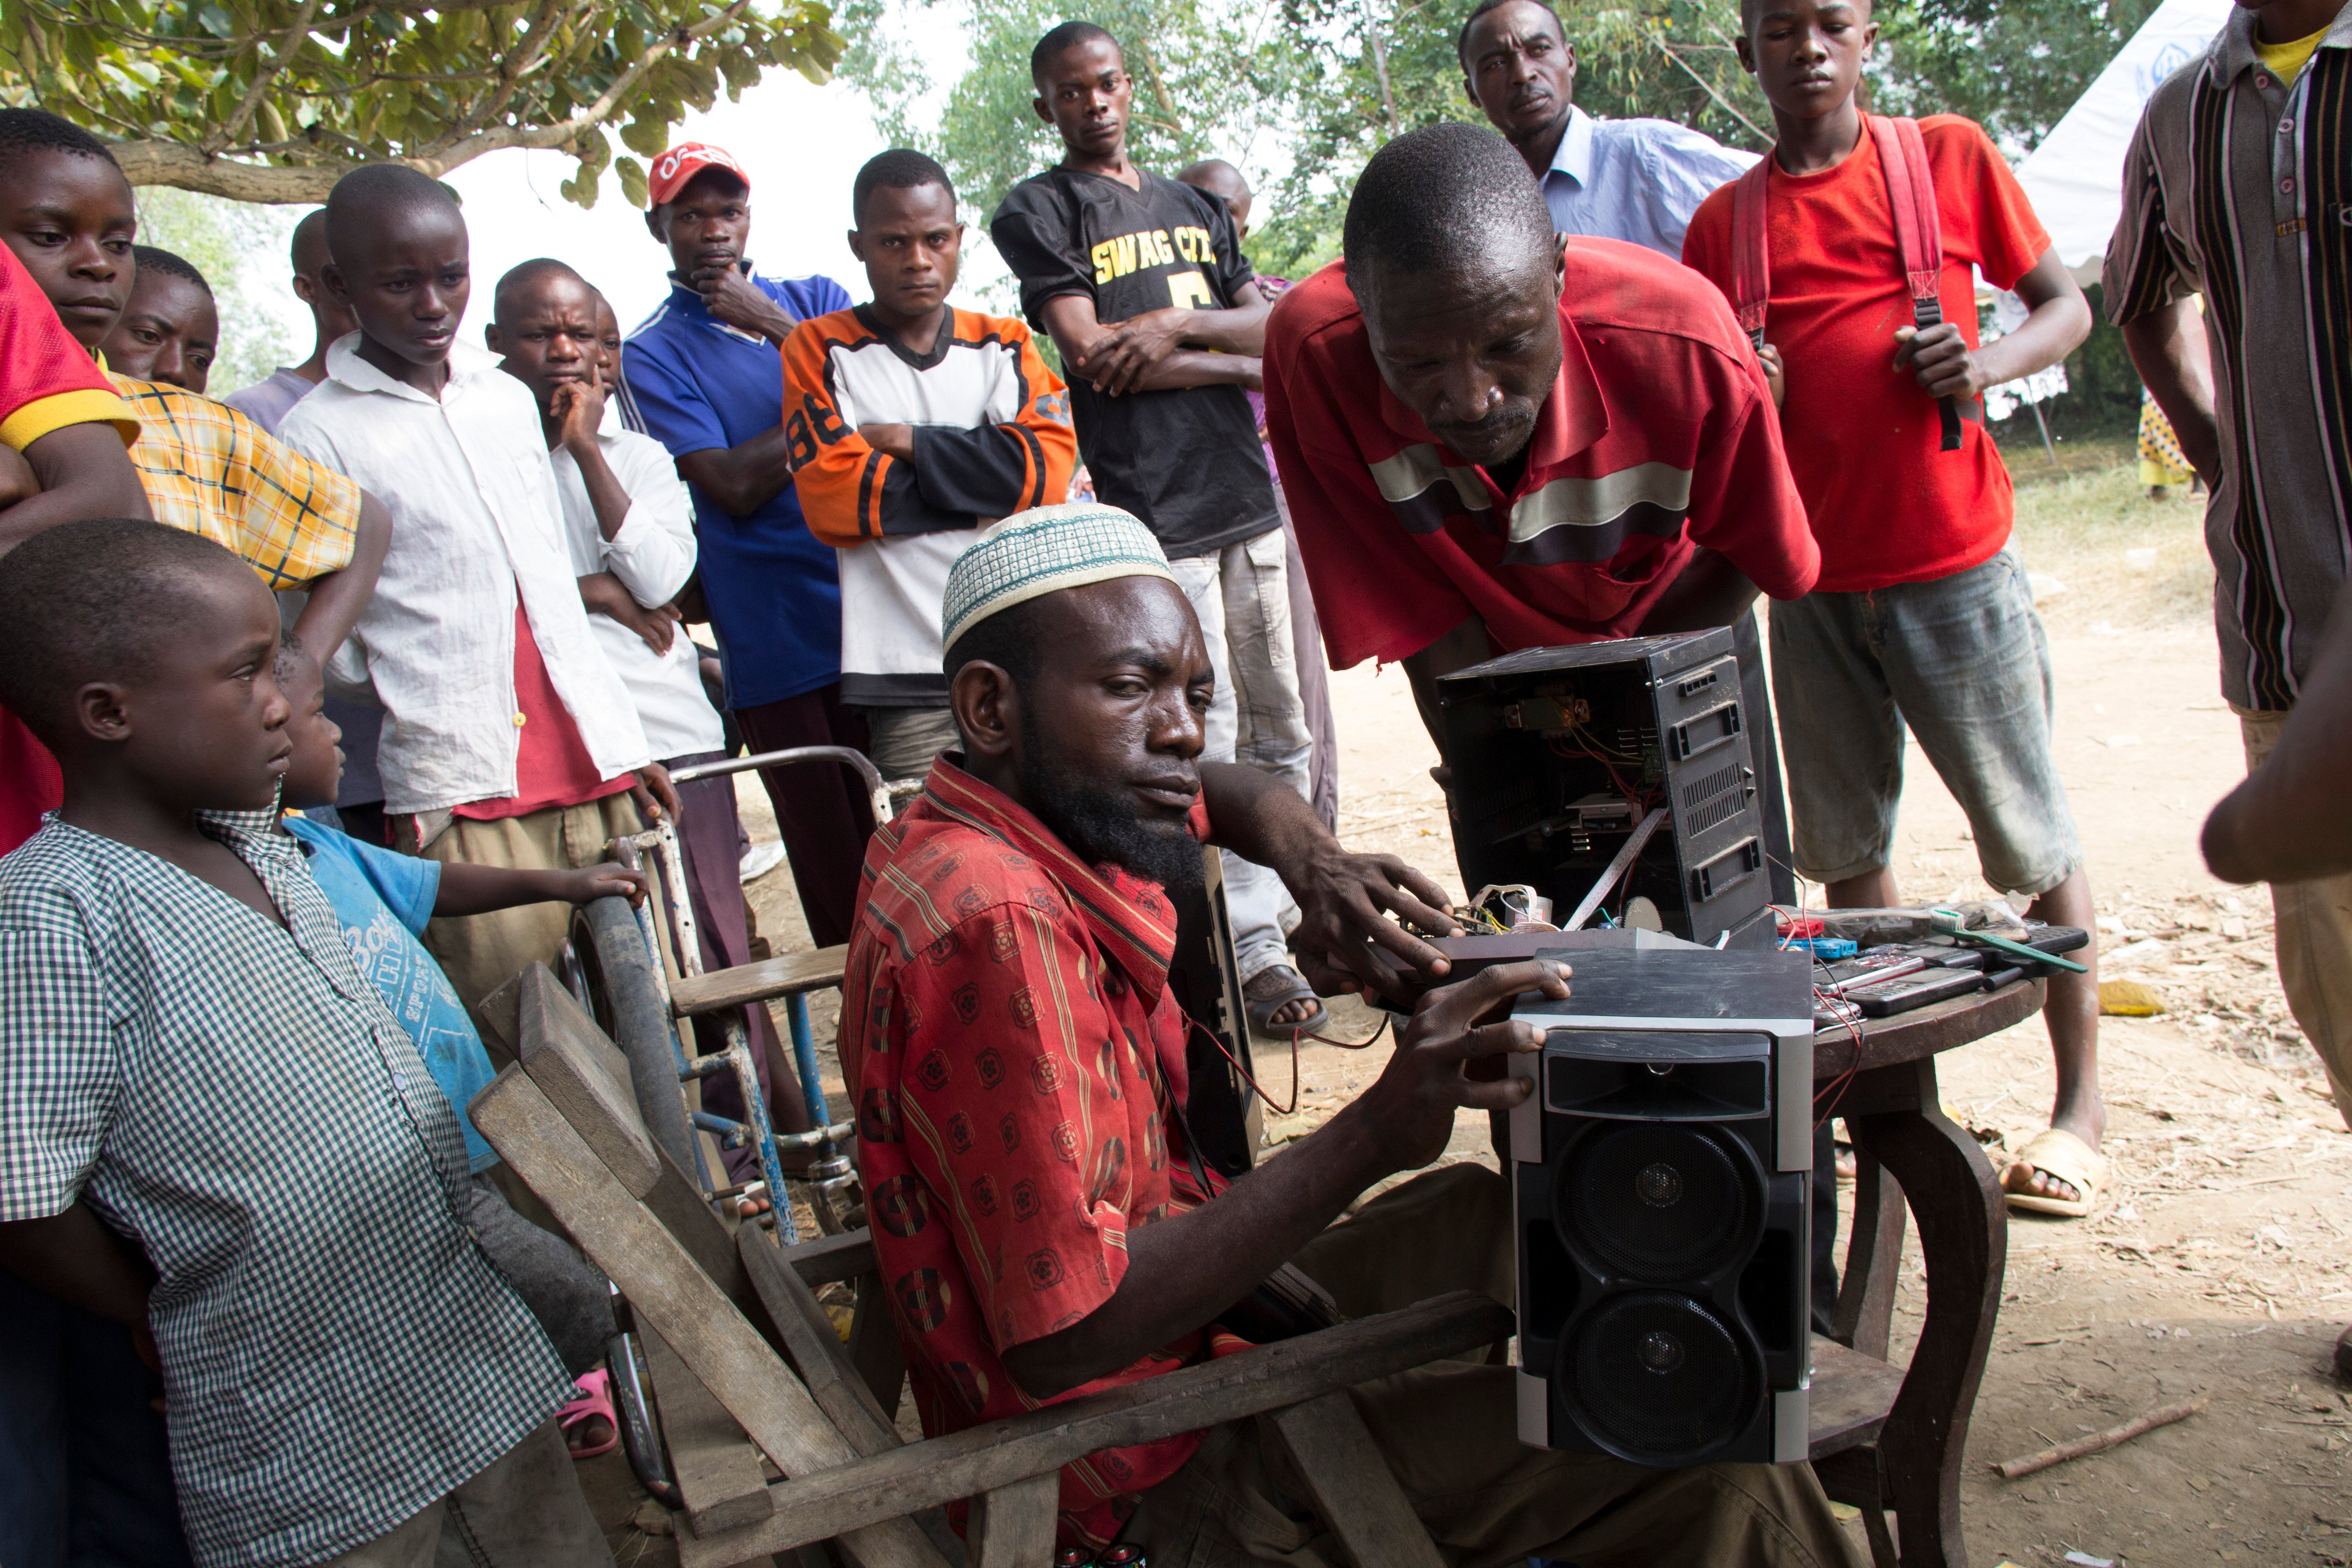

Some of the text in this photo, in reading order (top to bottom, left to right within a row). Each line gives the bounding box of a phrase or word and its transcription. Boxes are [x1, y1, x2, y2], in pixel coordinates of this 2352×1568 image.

[1092, 230, 1174, 284] SWAG
[785, 392, 855, 472] 86
[405, 954, 429, 1023] SPORT
